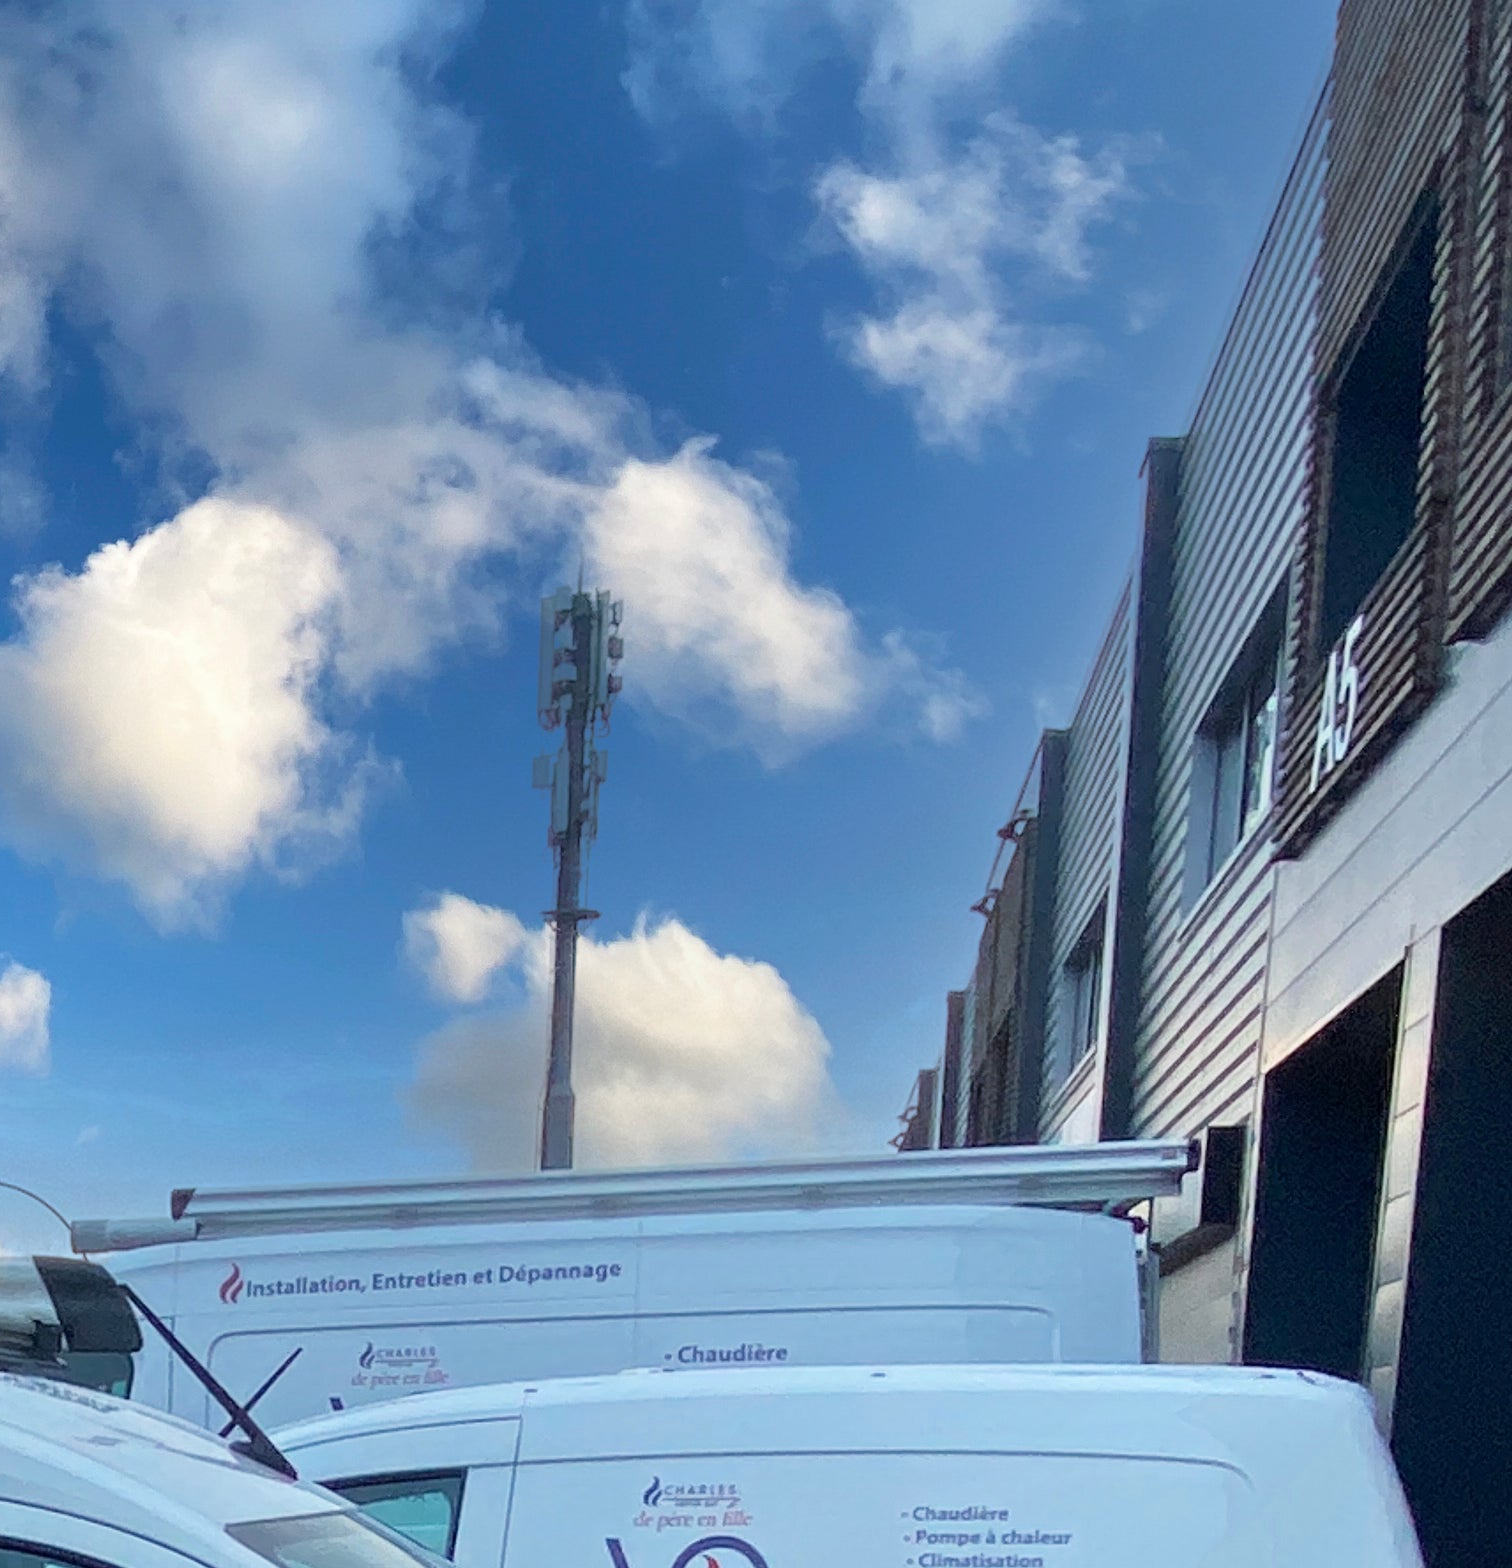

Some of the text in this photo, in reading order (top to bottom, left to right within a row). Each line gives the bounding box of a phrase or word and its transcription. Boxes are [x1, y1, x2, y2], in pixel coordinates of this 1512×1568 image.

[1308, 613, 1364, 794] A5
[246, 1261, 623, 1298] Installation, Entretien et Dépannage
[678, 1344, 789, 1364] Chaudière
[912, 1506, 1009, 1522] Chaudière
[915, 1530, 1073, 1546] Pompe à chaleur
[918, 1553, 1044, 1568] Climatisation
